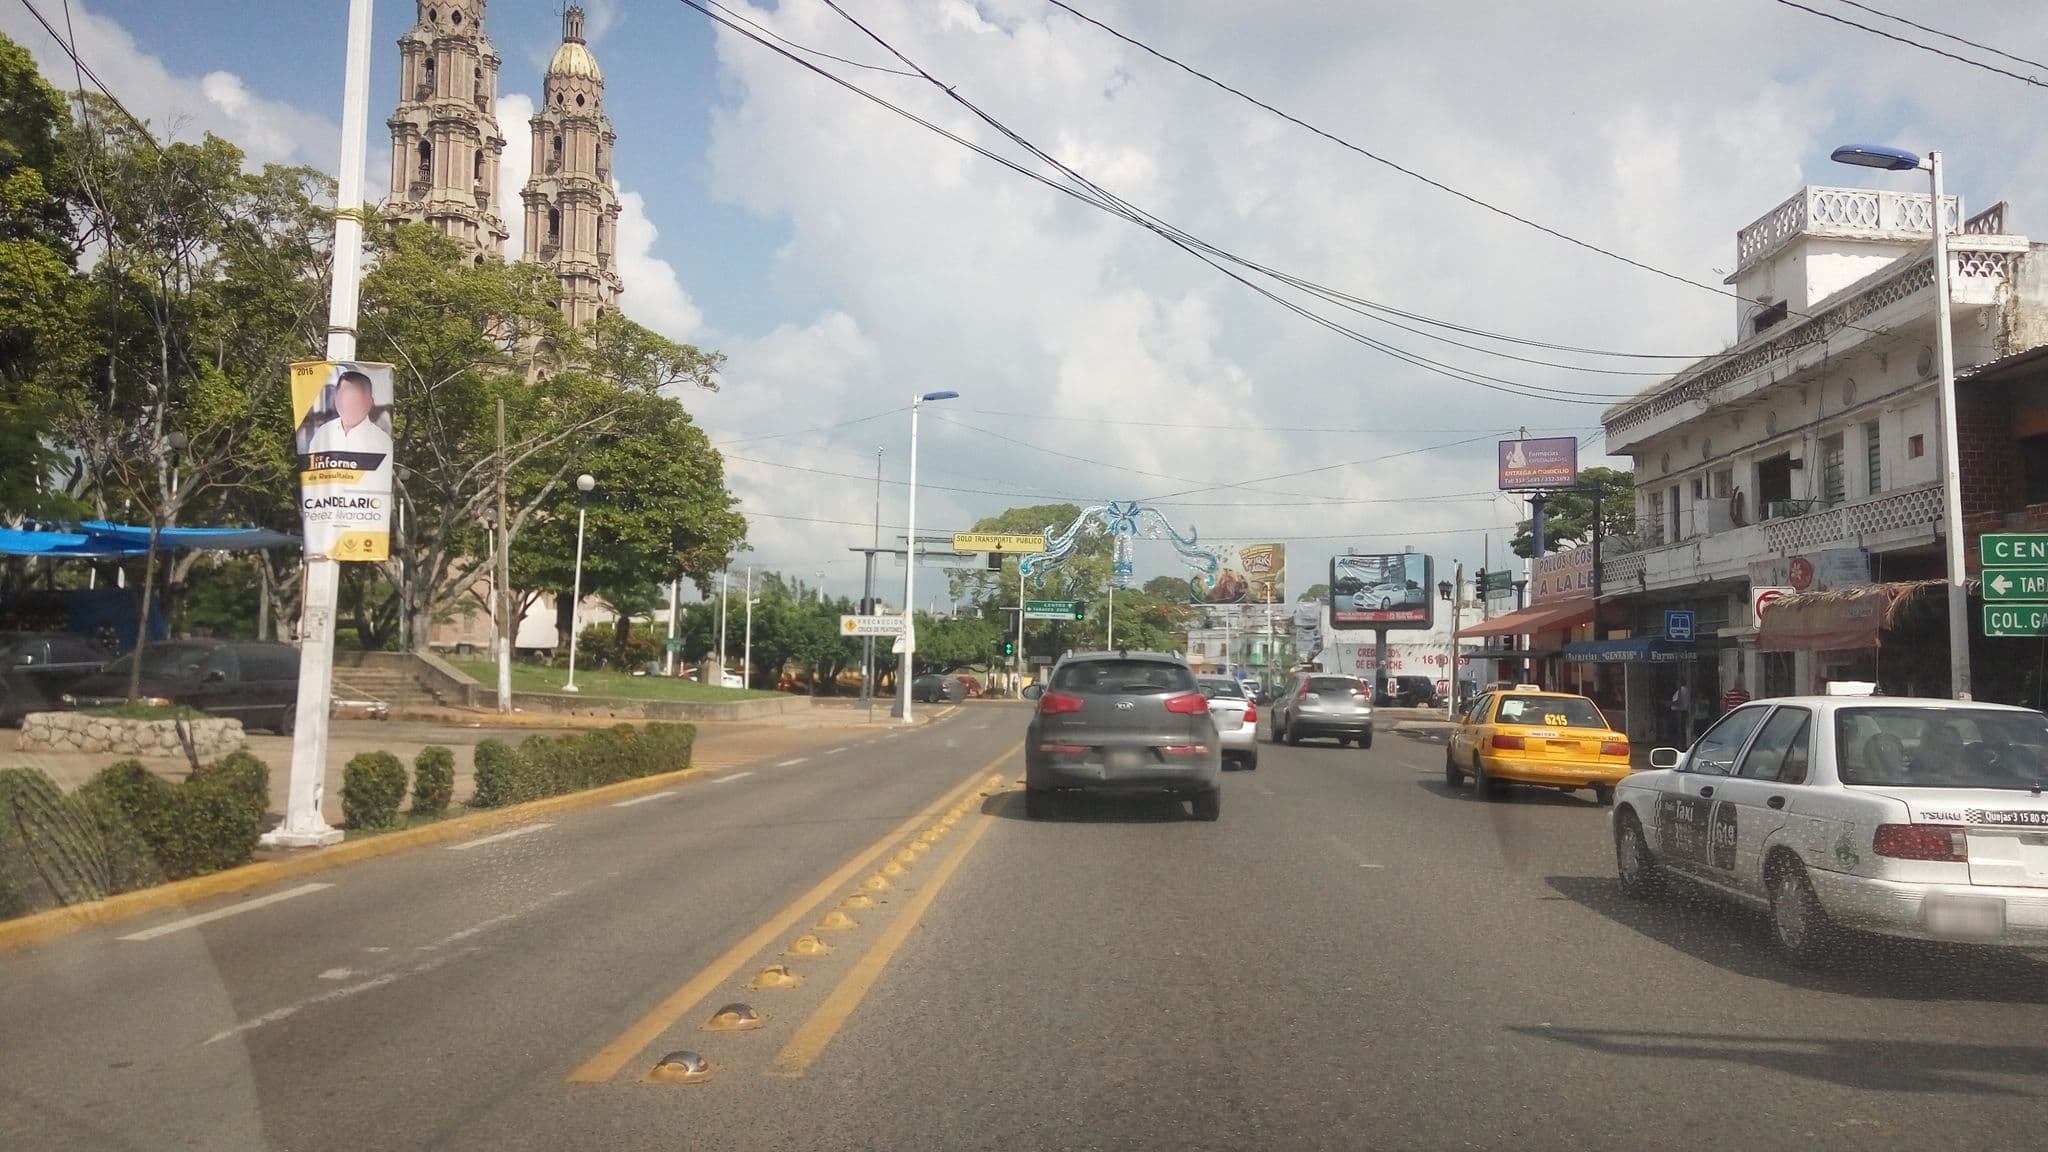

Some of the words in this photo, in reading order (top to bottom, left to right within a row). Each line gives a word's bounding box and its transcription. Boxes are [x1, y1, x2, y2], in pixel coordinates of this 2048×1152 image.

[297, 367, 314, 376] 2016
[304, 496, 382, 509] CANDELARIO
[1995, 542, 2048, 557] CEN
[1539, 554, 1567, 573] POLLOS
[1540, 580, 1548, 596] A
[1556, 575, 1572, 592] LA
[1578, 570, 1594, 589] LE
[2020, 577, 2048, 593] TAB
[1991, 612, 2028, 628] COL.
[1544, 713, 1568, 727] 6215
[1676, 800, 1695, 823] Taxi
[1920, 811, 1961, 821] TSURU
[1985, 811, 2011, 824] Quejas
[2012, 812, 2018, 821] 3
[2019, 813, 2029, 822] 15
[2030, 813, 2040, 823] 80
[1716, 821, 1736, 846] 619
